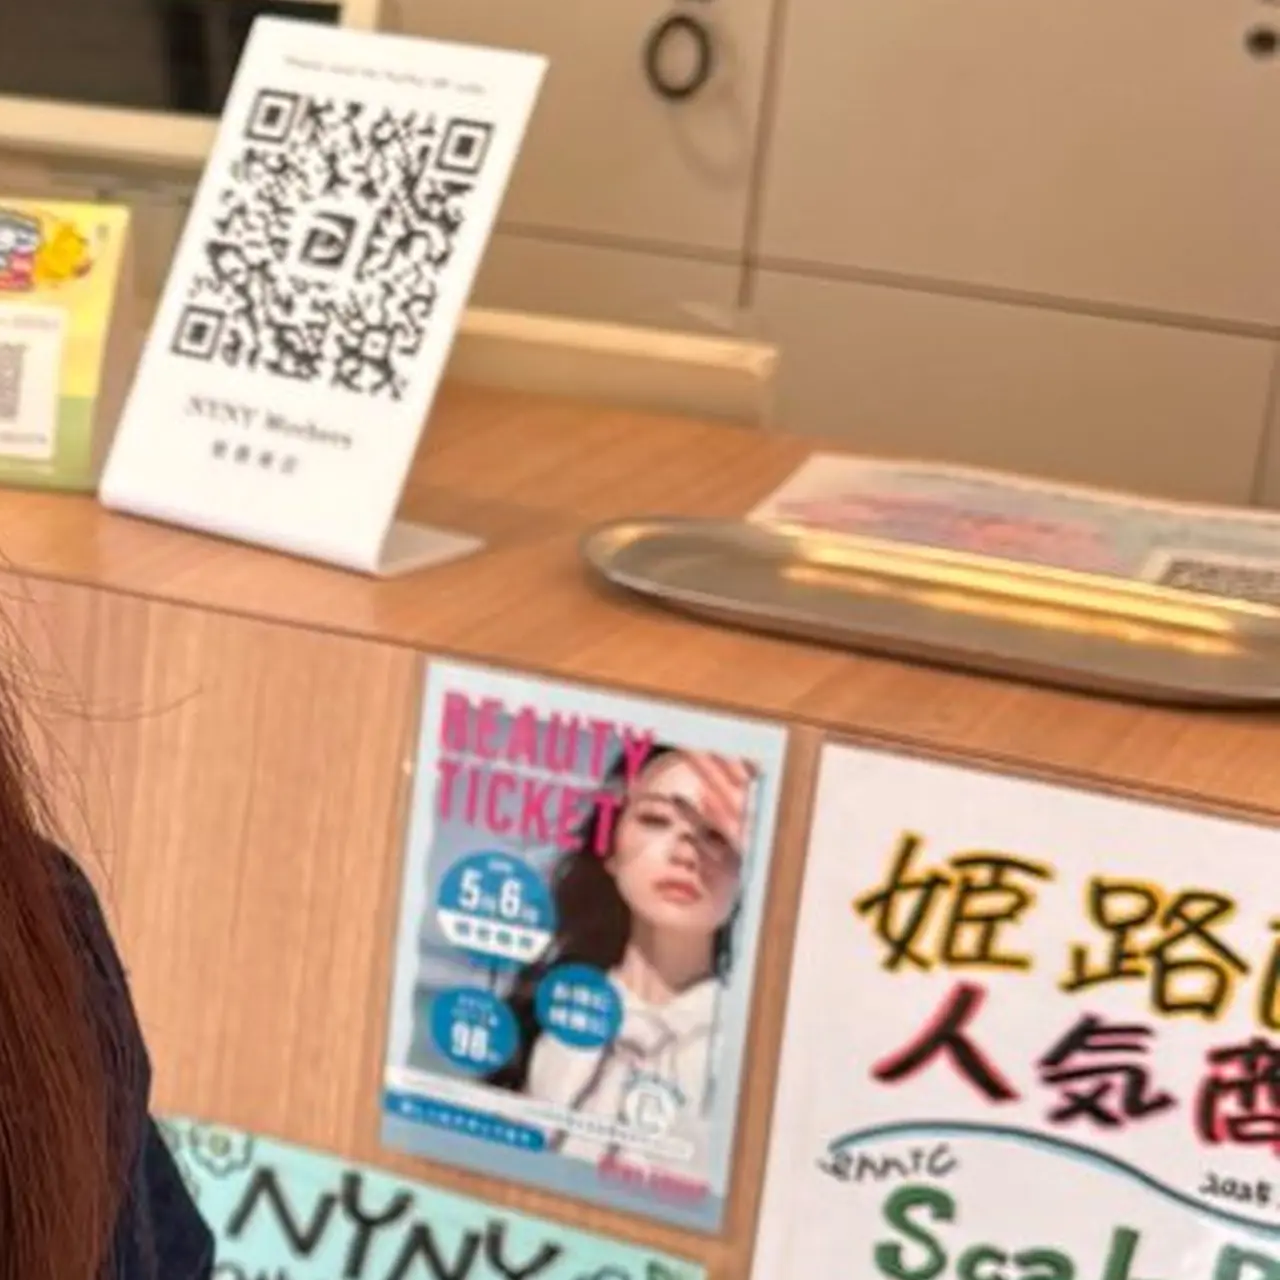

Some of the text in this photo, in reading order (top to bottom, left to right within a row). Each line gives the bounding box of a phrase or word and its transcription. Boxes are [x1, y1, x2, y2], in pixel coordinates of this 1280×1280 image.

[441, 690, 656, 788] BEAUTY
[437, 757, 616, 858] TICKET
[852, 830, 1280, 1032] 姫路
